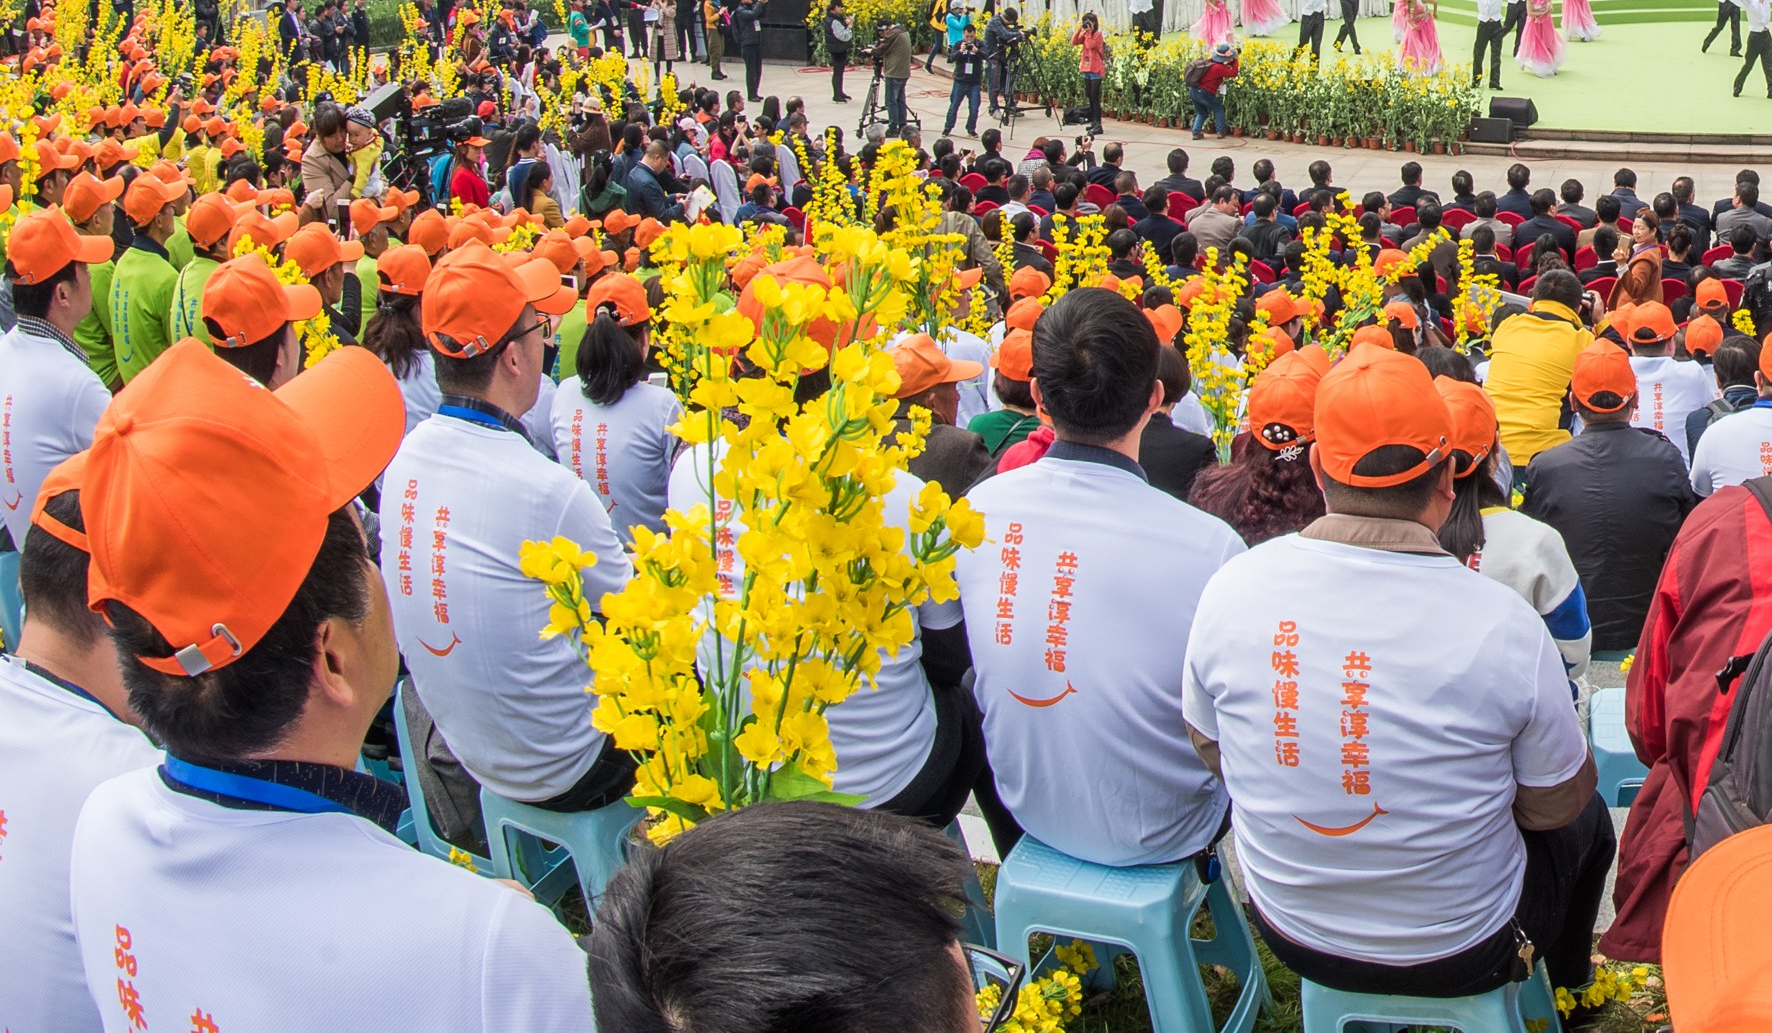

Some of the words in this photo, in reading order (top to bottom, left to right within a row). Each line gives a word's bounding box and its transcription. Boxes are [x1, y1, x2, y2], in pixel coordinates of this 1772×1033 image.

[595, 423, 610, 496] 共享淳幸福
[1653, 382, 1664, 431] 共享淳幸福
[398, 479, 419, 597] 品味慢生活
[431, 505, 451, 625] 共享淳幸福
[996, 522, 1023, 645] 品味慢生活
[1044, 551, 1079, 673] 共享淳幸福
[1271, 620, 1300, 768] 品味慢生活
[1340, 650, 1373, 796] 共享淳幸福
[114, 923, 148, 1033] 品味
